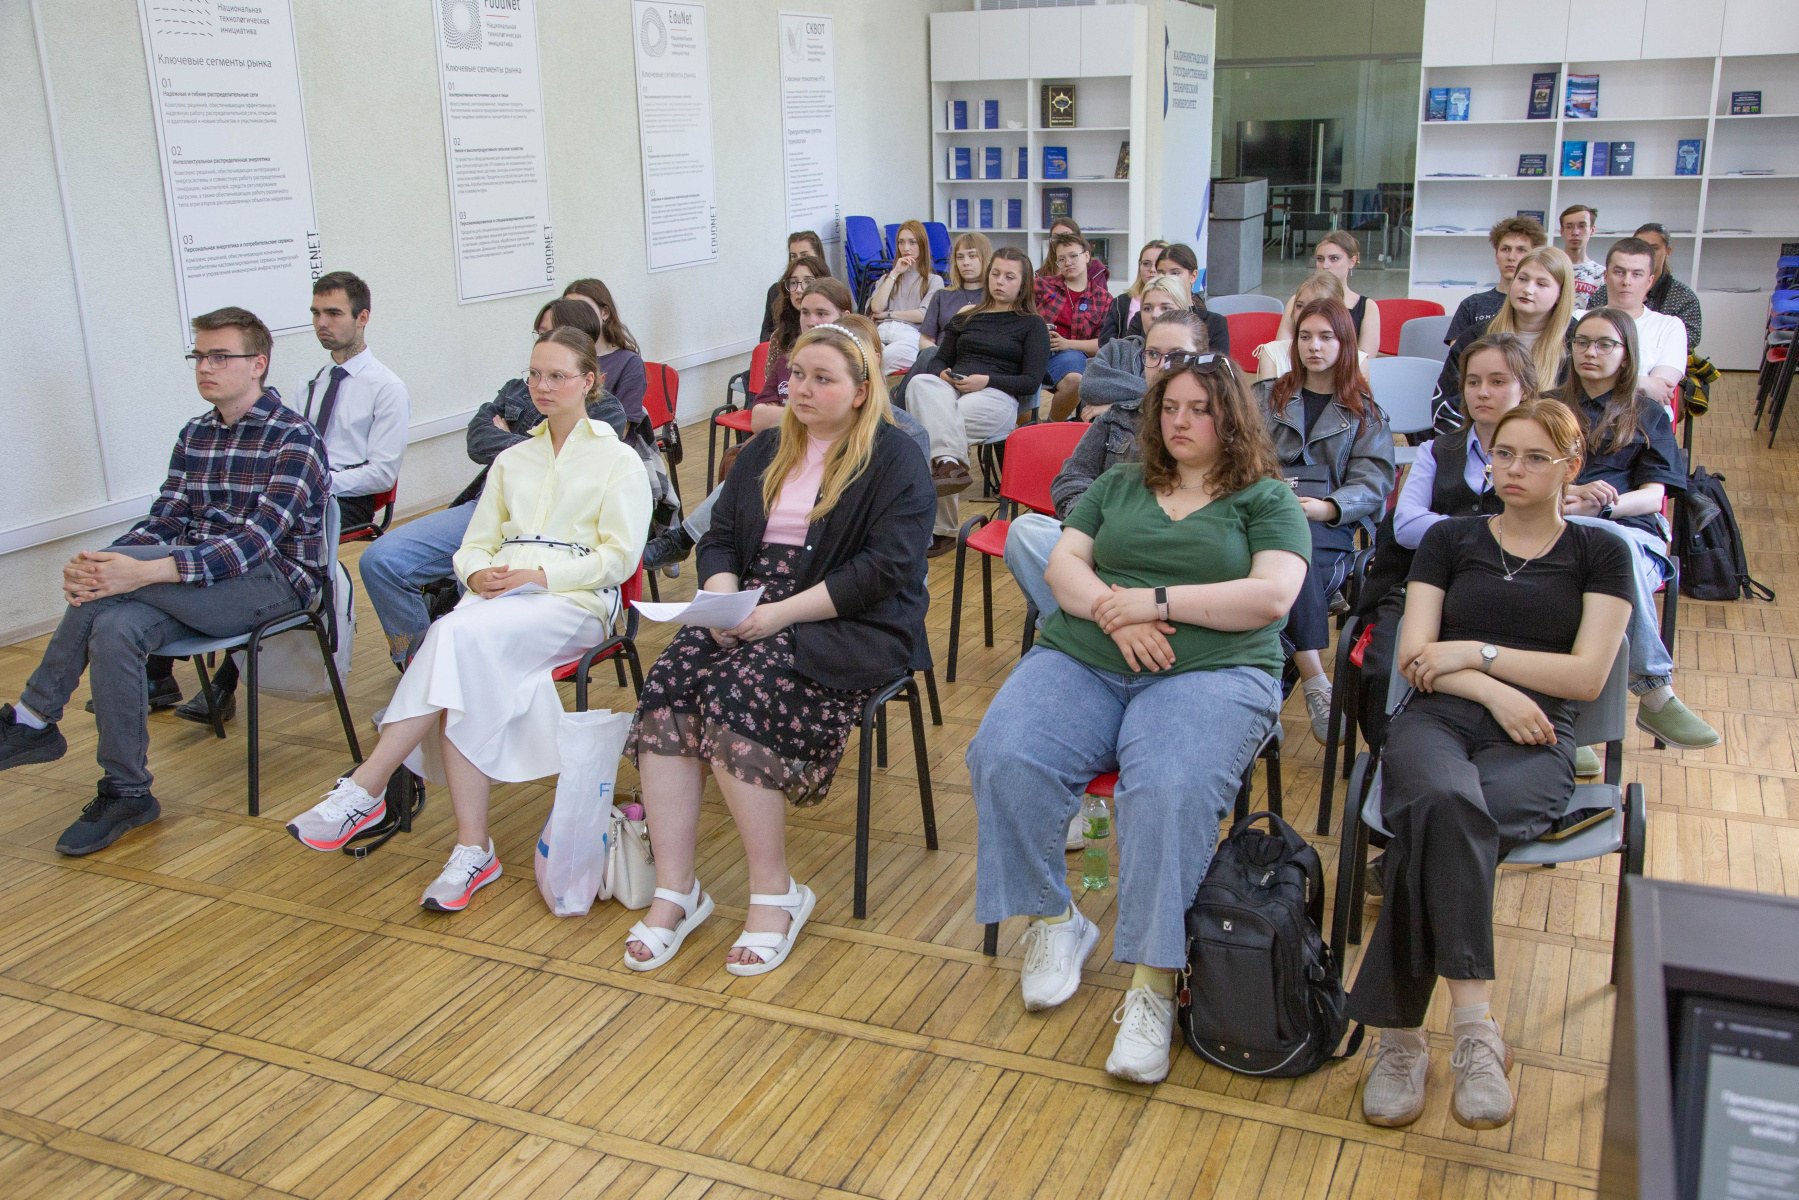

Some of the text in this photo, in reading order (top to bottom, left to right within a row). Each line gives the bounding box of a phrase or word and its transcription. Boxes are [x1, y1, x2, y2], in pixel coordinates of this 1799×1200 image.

[218, 3, 262, 14] Национальная
[669, 10, 692, 24] EduNet
[220, 27, 257, 35] инициатива
[806, 23, 825, 34] СКВОТ
[158, 54, 272, 69] Ключевые сегменты рынка
[446, 63, 476, 72] Ключевые
[505, 67, 522, 75] рынка
[162, 78, 172, 88] 01
[448, 82, 455, 90] 01
[171, 146, 182, 155] 02
[183, 235, 193, 244] 03
[544, 224, 555, 282] FOODNET
[307, 230, 323, 288] RENET
